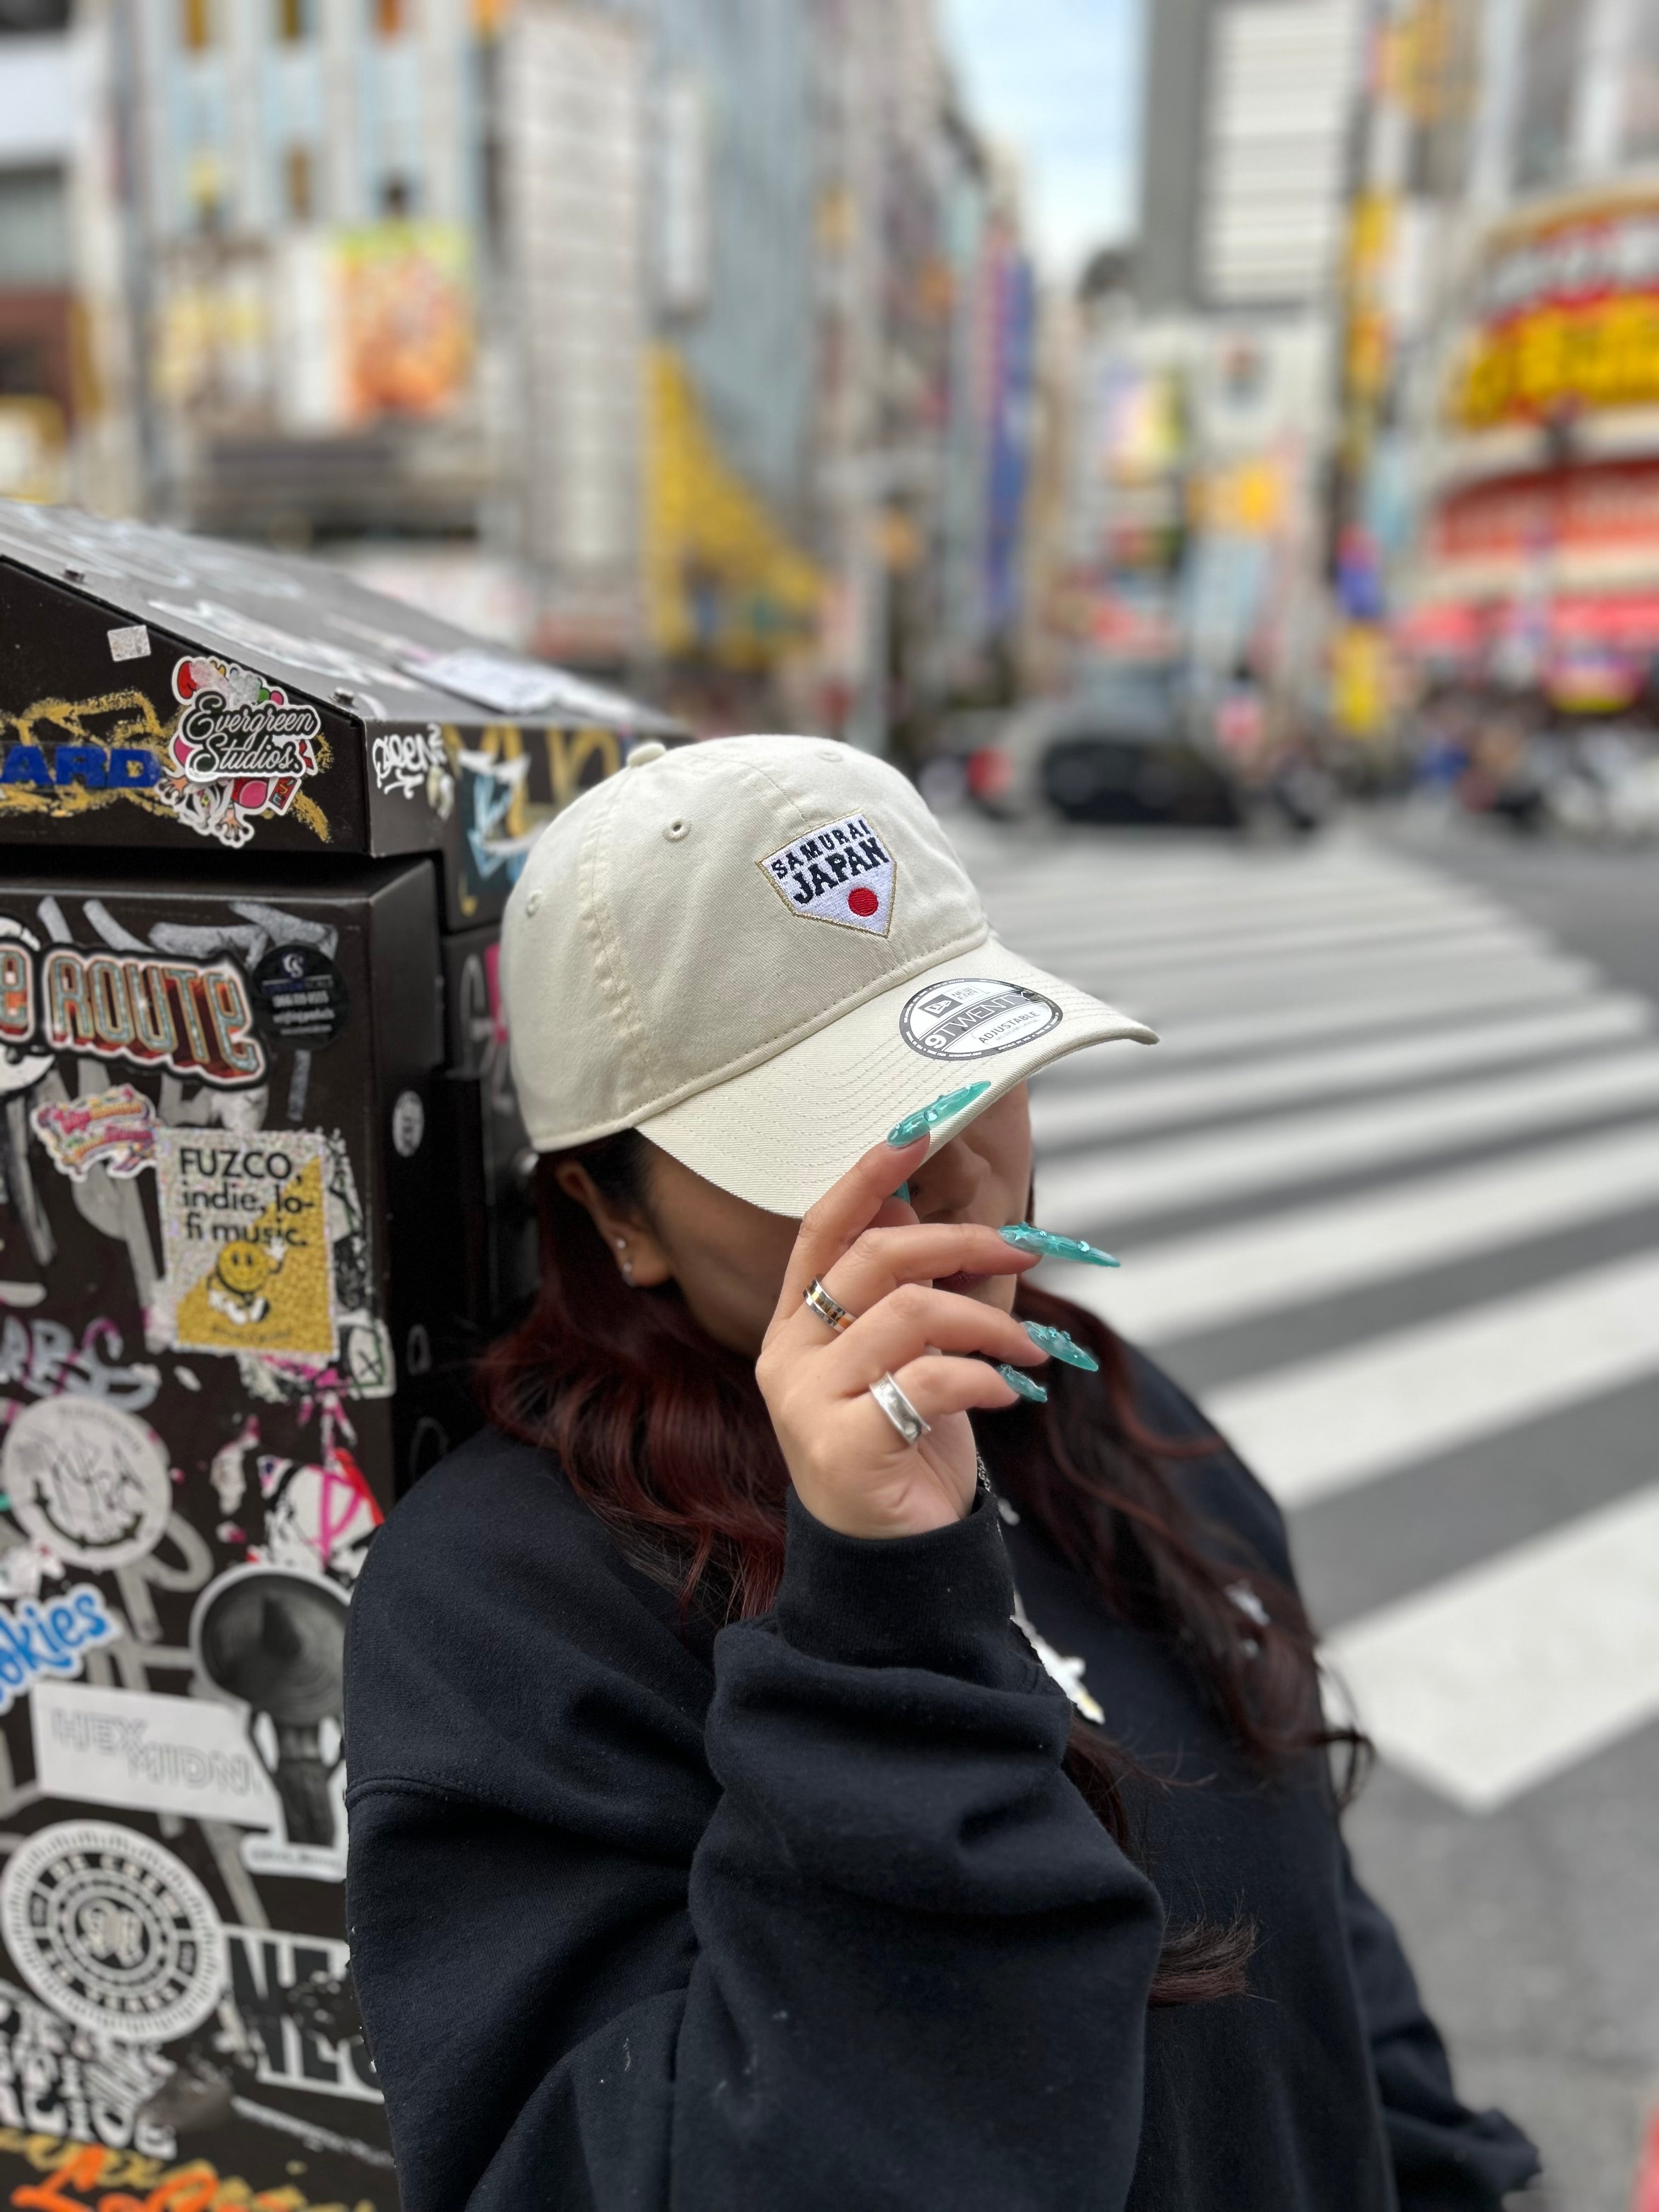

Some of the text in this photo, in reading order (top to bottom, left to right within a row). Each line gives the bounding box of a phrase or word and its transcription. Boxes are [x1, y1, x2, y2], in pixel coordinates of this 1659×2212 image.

[187, 695, 314, 751] Evergreen
[771, 820, 871, 879] SAMURAI
[793, 837, 889, 904] JAPAN
[951, 987, 973, 997] NEW
[957, 990, 979, 1000] ERA
[978, 1011, 1041, 1043] ADJUSTABLE
[179, 1148, 303, 1186] FUZCO,
[183, 1181, 314, 1215] indie, lo-
[0, 1594, 106, 1692] okies
